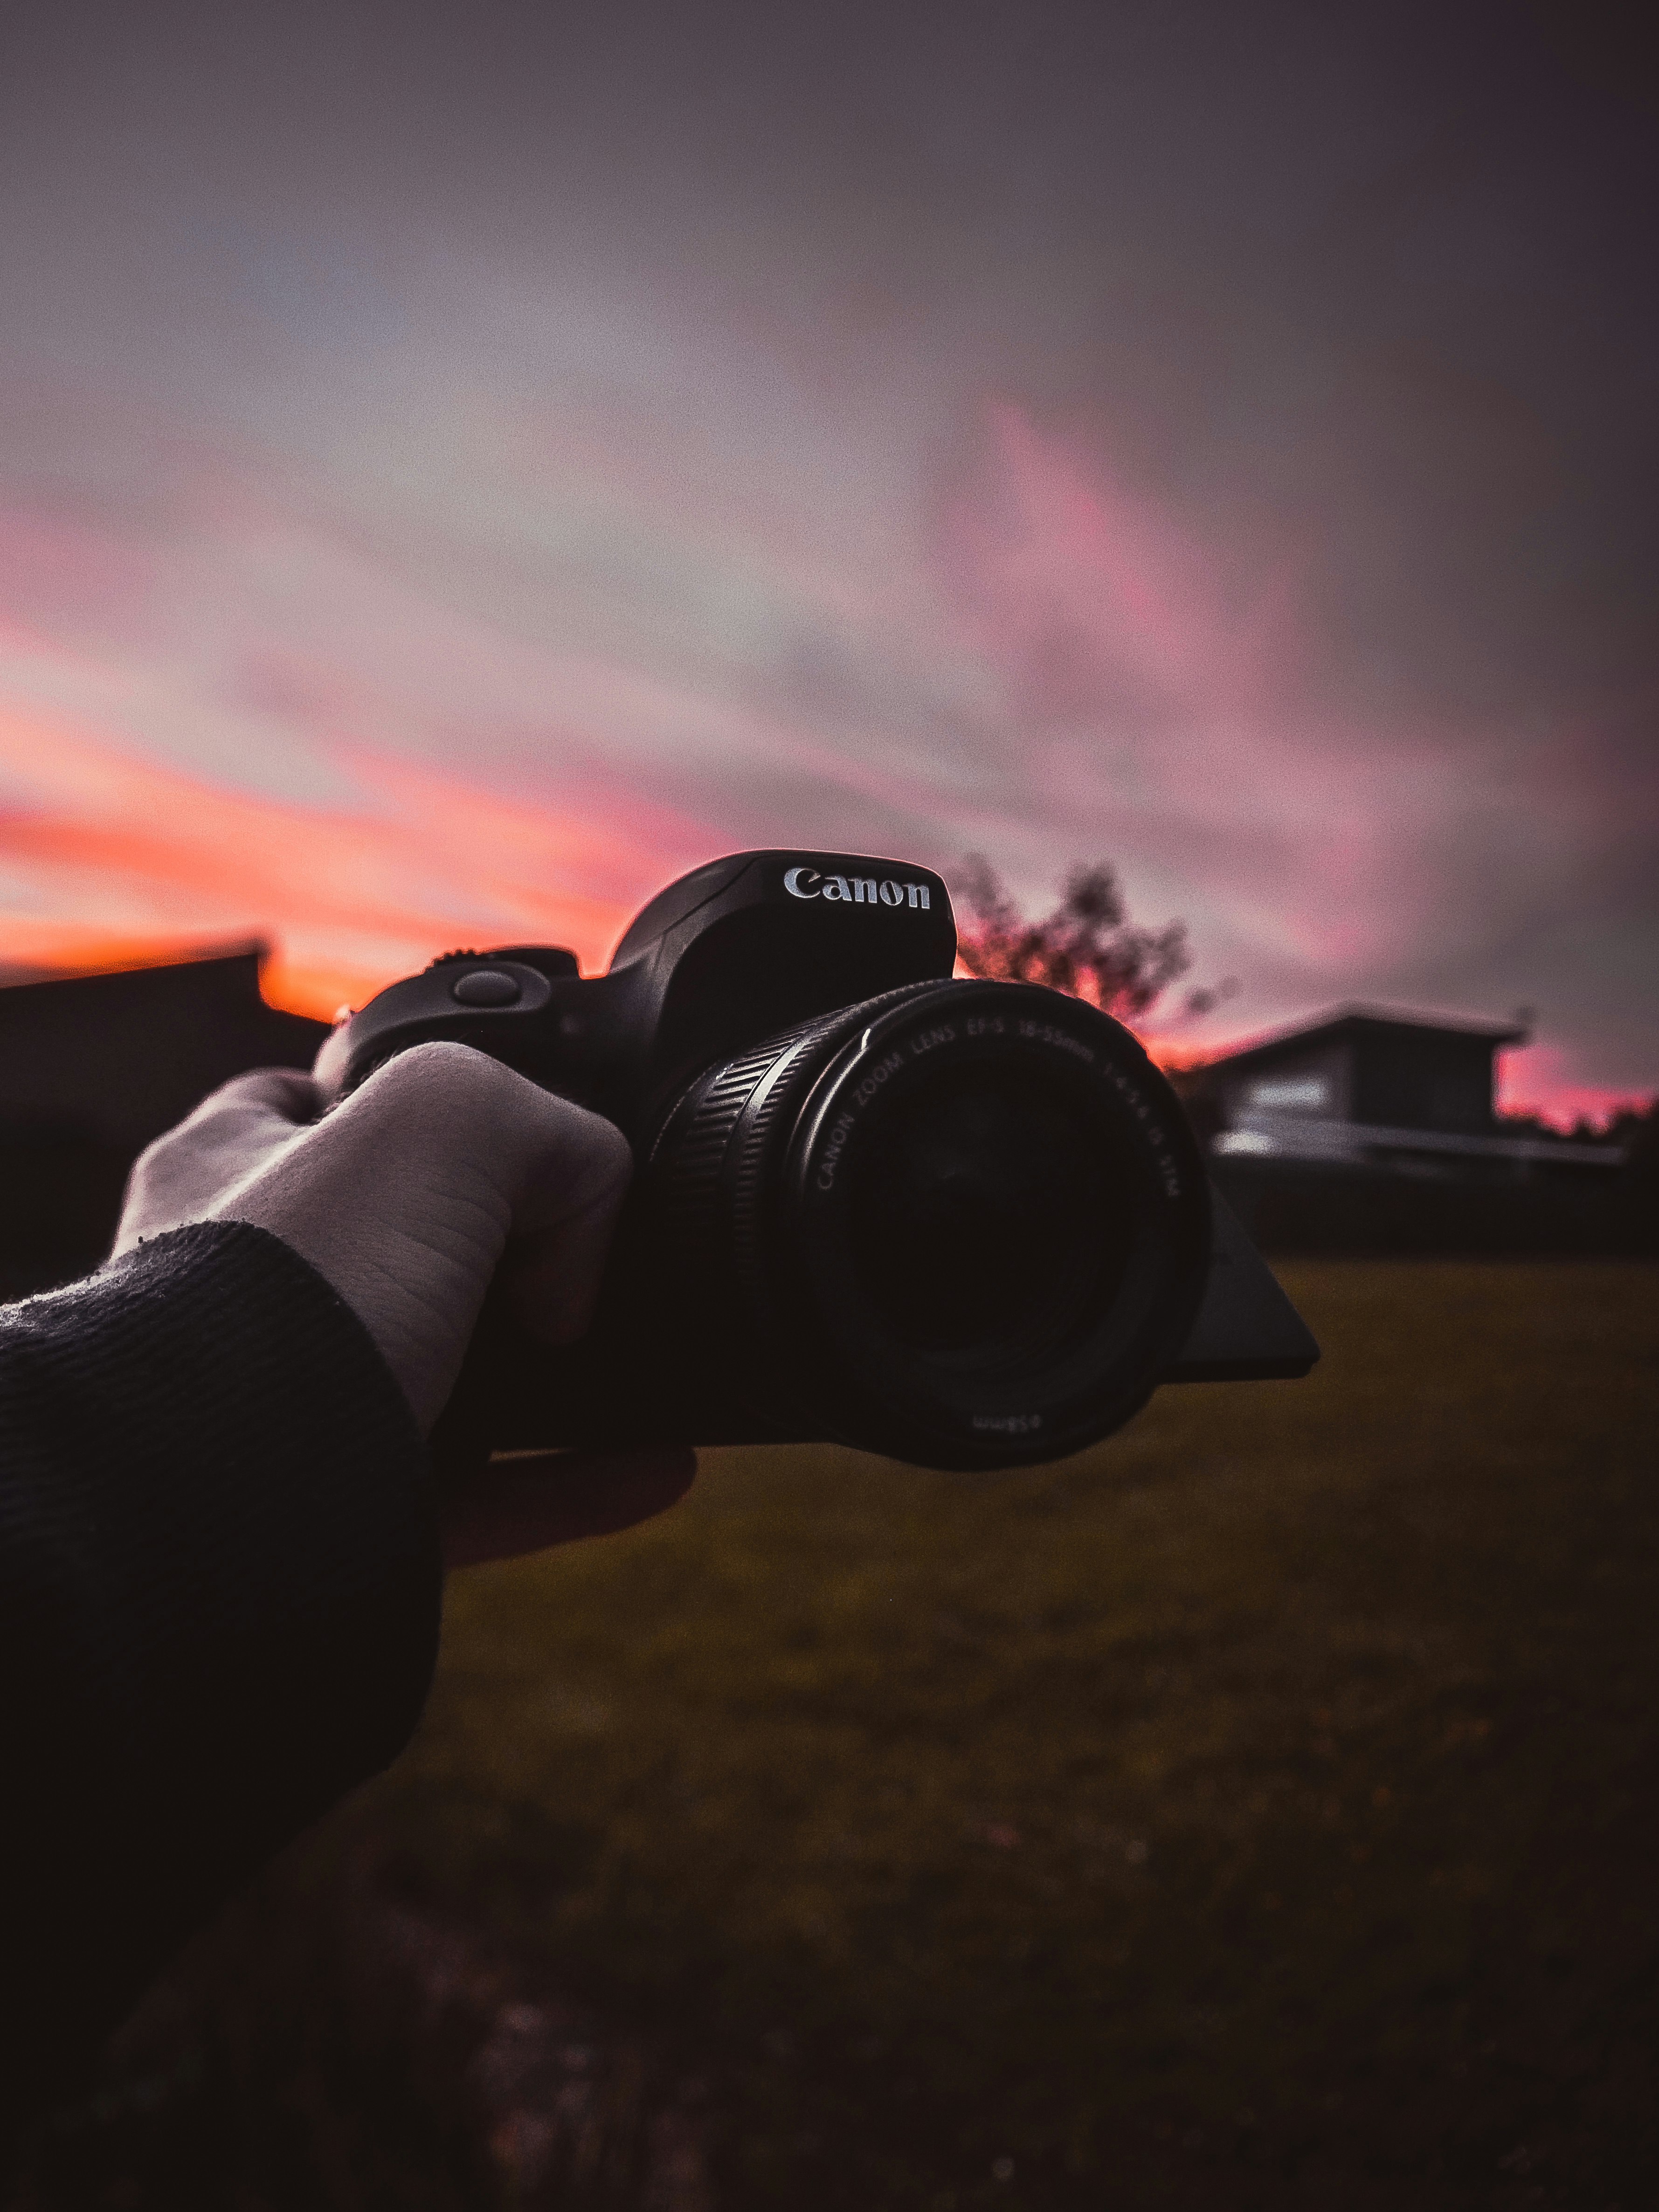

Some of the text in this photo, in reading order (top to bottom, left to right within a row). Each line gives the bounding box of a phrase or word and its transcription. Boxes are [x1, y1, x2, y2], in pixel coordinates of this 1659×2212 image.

[784, 867, 930, 909] Canon
[817, 1112, 855, 1189] CANON
[852, 1051, 904, 1106] ZOOM
[911, 1025, 956, 1054] LENS
[1160, 1154, 1181, 1196] STM
